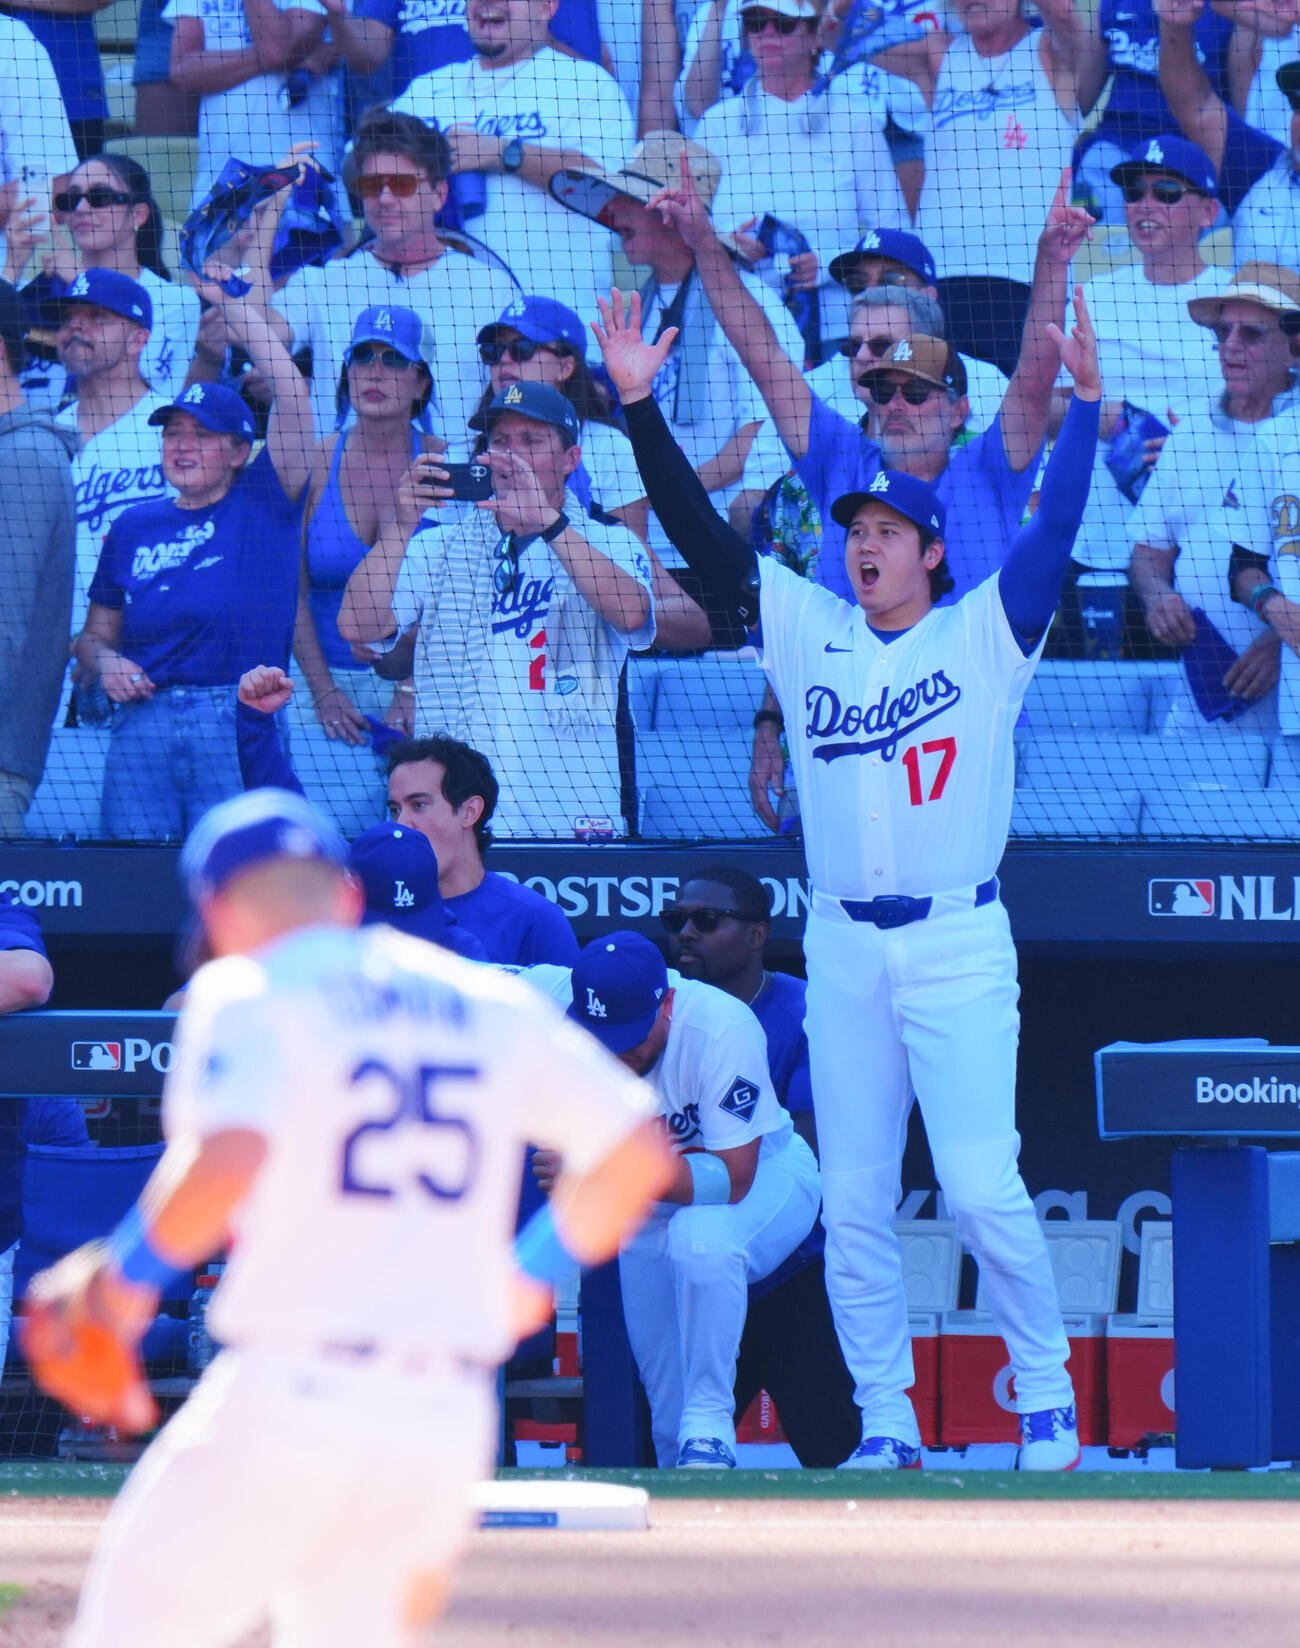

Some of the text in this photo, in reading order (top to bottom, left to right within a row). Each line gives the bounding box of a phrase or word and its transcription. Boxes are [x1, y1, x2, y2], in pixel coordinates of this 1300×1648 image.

[893, 339, 913, 361] LA
[504, 384, 523, 404] LA
[76, 463, 168, 533] dgers
[869, 471, 890, 492] LA
[805, 669, 961, 765] Dodgers
[902, 736, 957, 807] 17
[394, 880, 415, 907] LA
[495, 871, 813, 917] OSTSEON
[1219, 875, 1300, 920] NL
[586, 988, 607, 1017] LA
[1196, 1076, 1300, 1110] Bookin
[342, 1057, 482, 1200] 25
